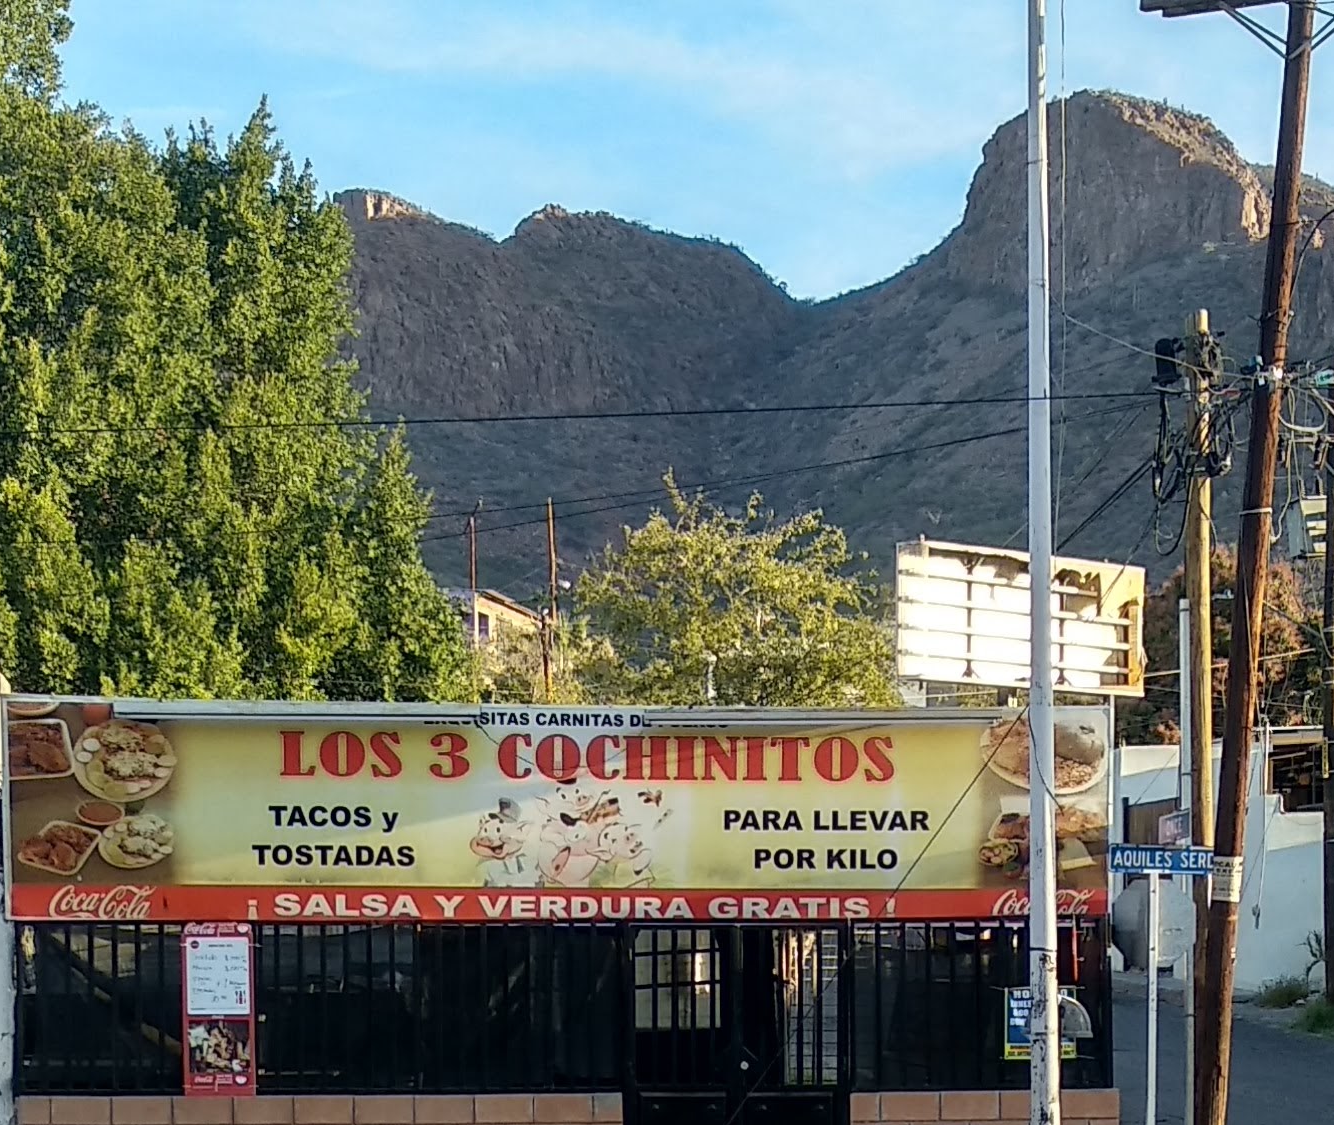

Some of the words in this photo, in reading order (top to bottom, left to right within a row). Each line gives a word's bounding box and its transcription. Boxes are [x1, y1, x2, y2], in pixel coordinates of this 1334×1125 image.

[536, 712, 624, 727] CARNITAS
[279, 730, 403, 779] LOS
[429, 732, 471, 779] 3
[497, 732, 896, 783] COCHINITOS
[268, 804, 372, 828] TACOS
[381, 810, 400, 833] y
[723, 809, 804, 832] PARA
[813, 810, 931, 833] LLEVAR
[252, 843, 416, 867] TOSTADAS
[754, 848, 817, 870] POR
[826, 848, 899, 871] KILO
[1113, 850, 1173, 868] AQUILES
[49, 885, 156, 919] Coca-Cola
[274, 893, 426, 918] SALSA
[434, 894, 465, 918] Y
[478, 895, 692, 919] VERDURA
[708, 896, 871, 919] GRATIS
